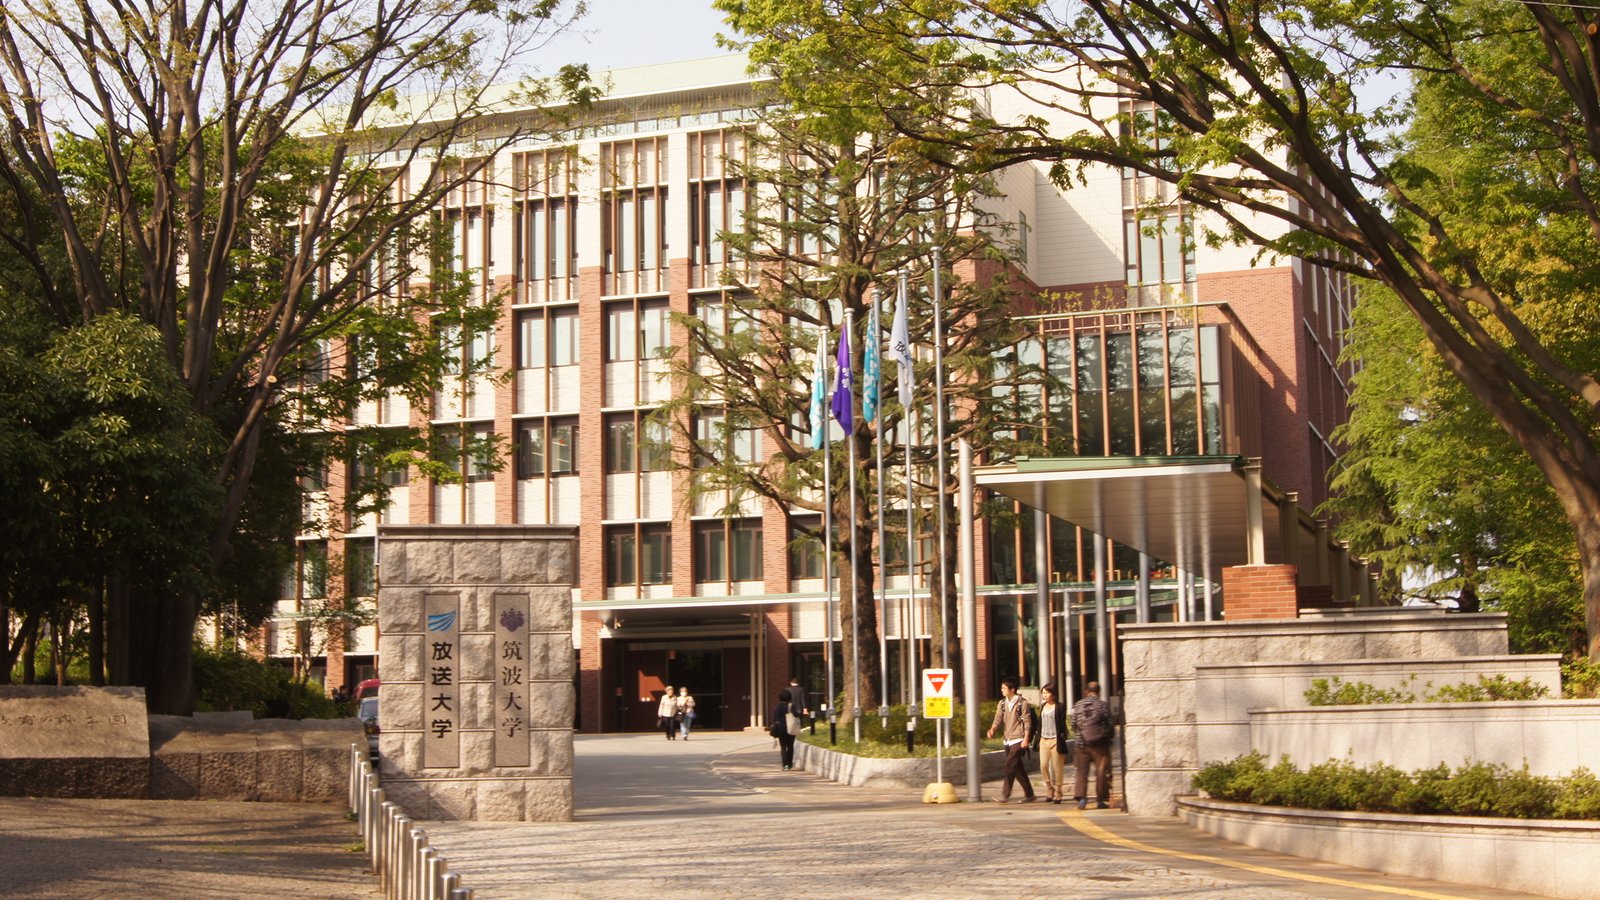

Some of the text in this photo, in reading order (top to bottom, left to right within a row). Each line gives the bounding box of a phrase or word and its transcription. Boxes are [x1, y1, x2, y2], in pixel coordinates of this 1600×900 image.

[431, 641, 453, 739] 放送大学
[501, 640, 523, 738] 筑波大学
